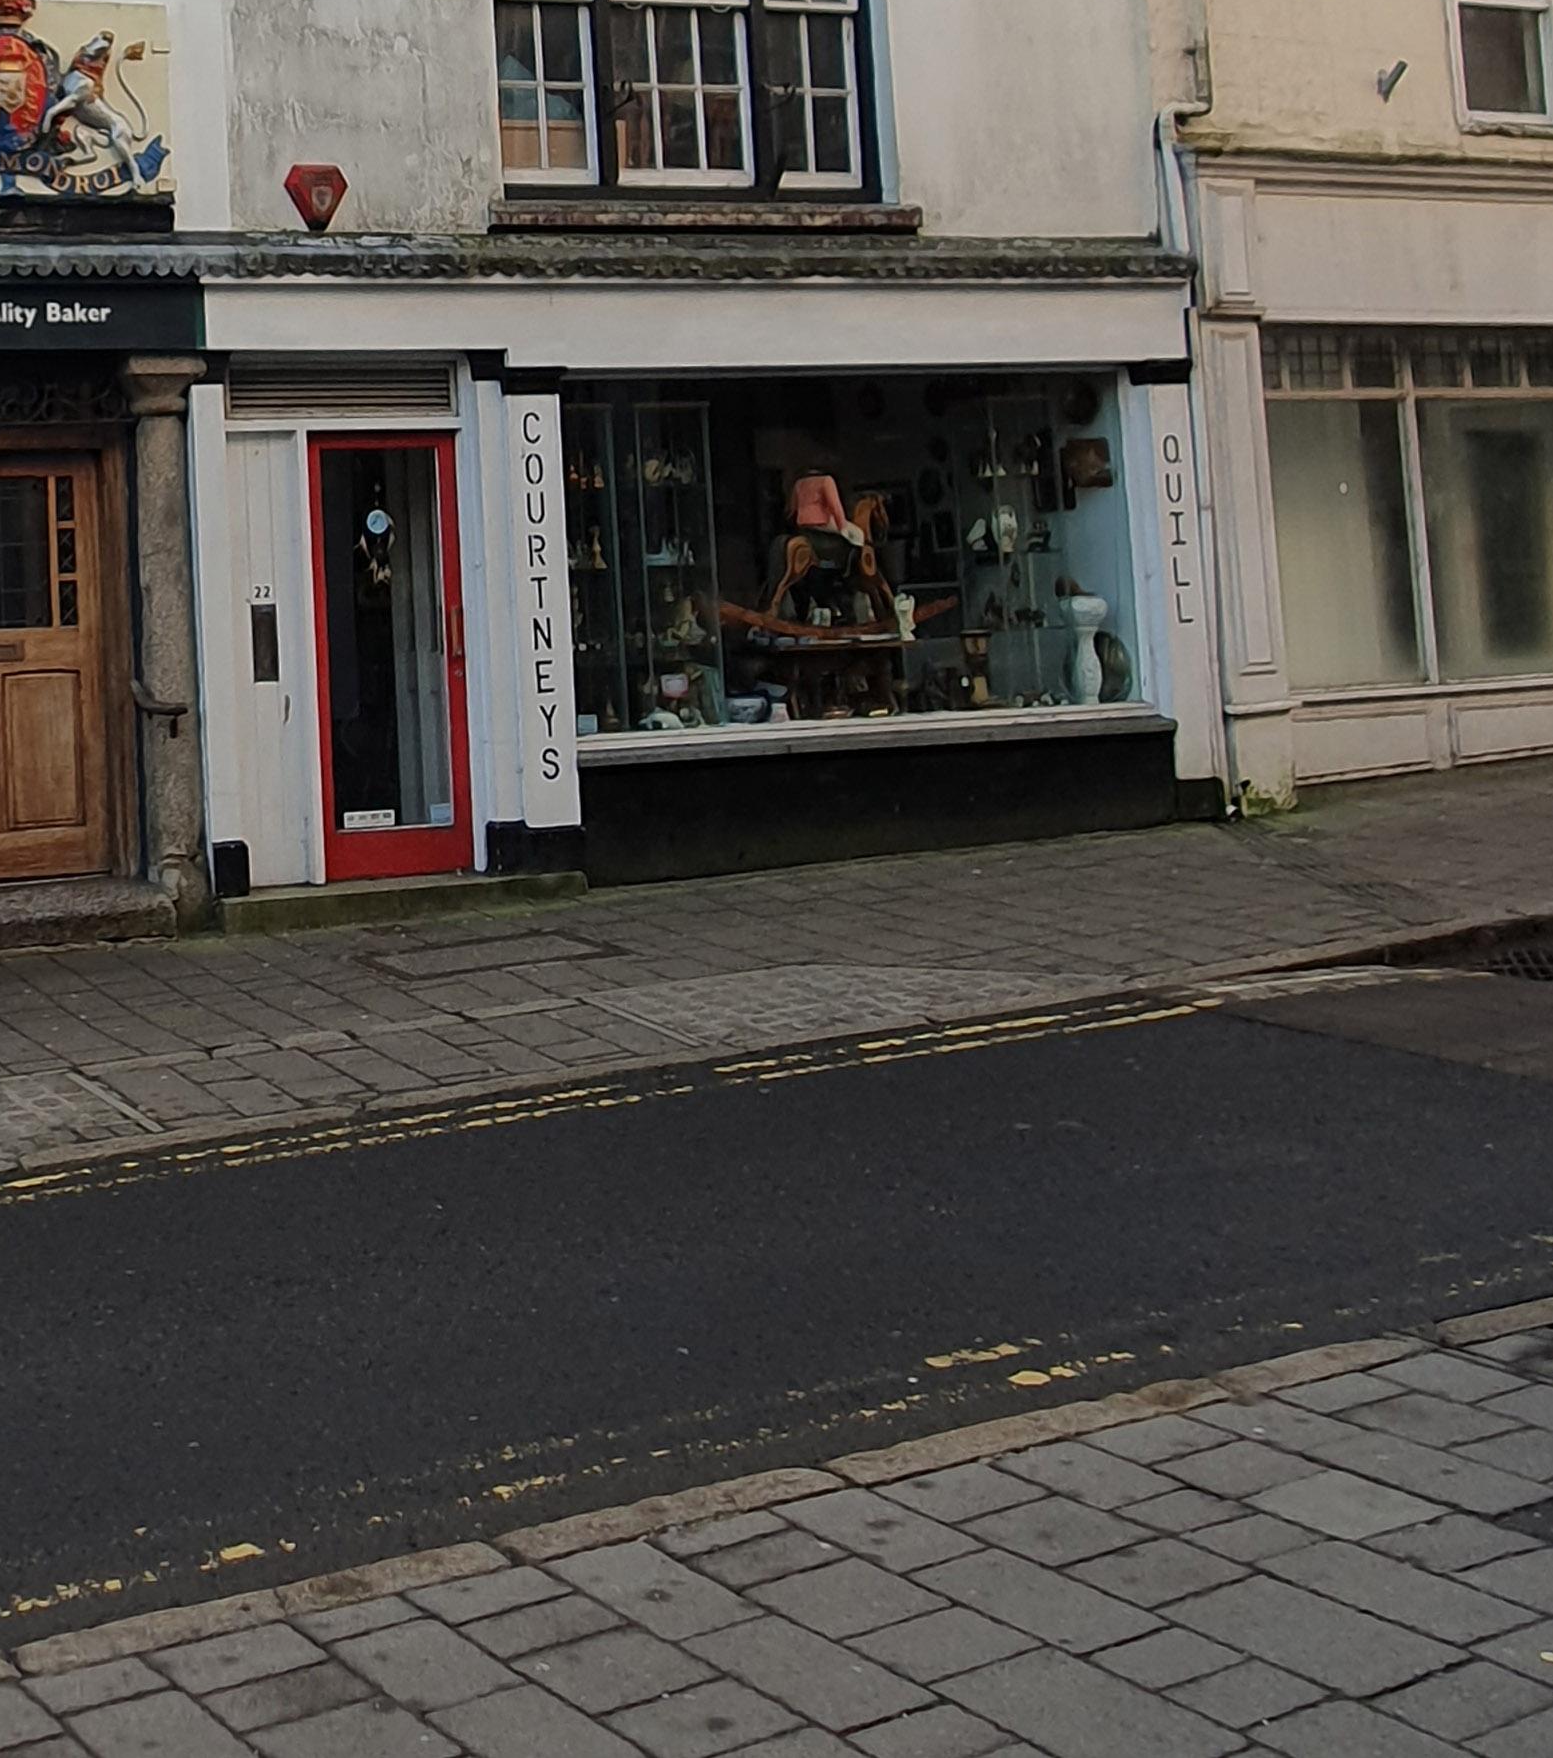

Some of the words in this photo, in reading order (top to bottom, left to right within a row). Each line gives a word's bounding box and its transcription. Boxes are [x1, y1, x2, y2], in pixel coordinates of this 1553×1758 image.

[46, 301, 112, 323] Baker
[1162, 434, 1195, 624] QUILL
[254, 585, 272, 599] 22
[522, 411, 561, 781] COURTNEYS
